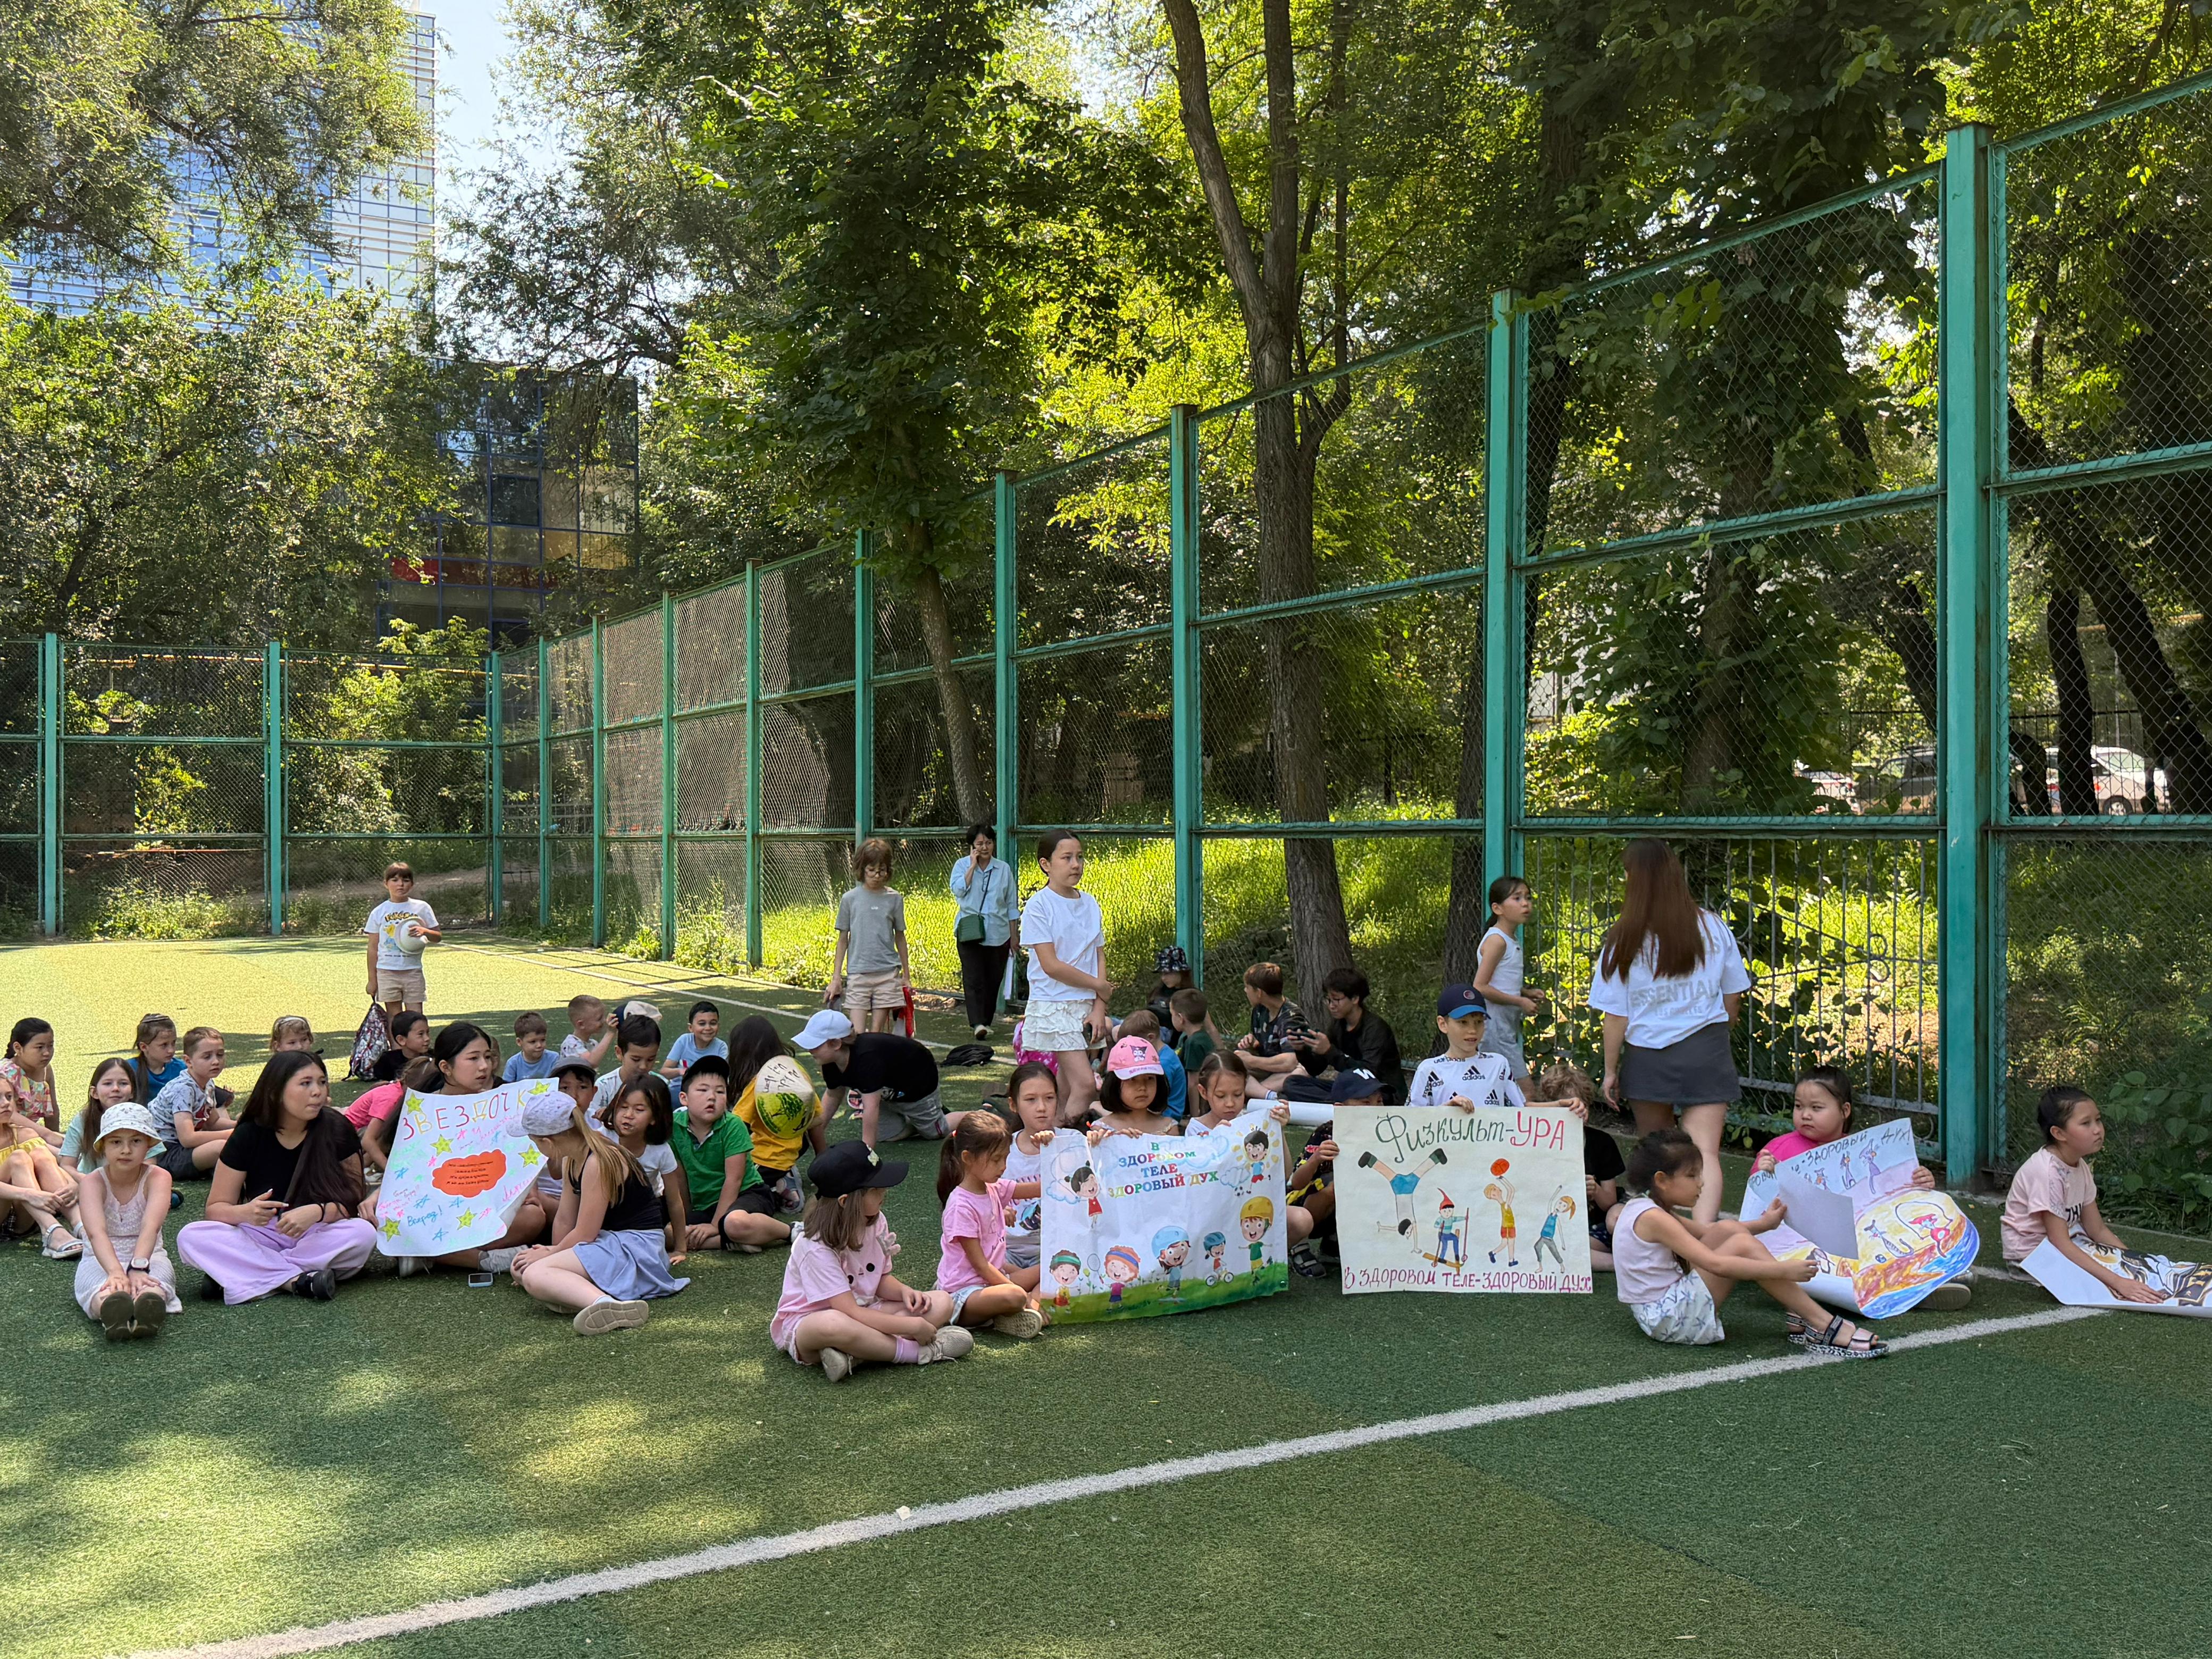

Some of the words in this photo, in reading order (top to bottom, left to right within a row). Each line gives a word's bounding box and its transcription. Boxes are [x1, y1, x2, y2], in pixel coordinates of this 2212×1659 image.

[1629, 980, 1720, 1008] ESSENTIAL
[403, 1090, 526, 1140] ЗВЕЗДОЧК
[1151, 1142, 1160, 1151] В
[1141, 1163, 1178, 1178] ТЕЛЕ
[1108, 1173, 1185, 1198] ЗДОРОВЫЙ
[1189, 1171, 1219, 1186] ДУХ
[1559, 1275, 1591, 1293] ДУХ
